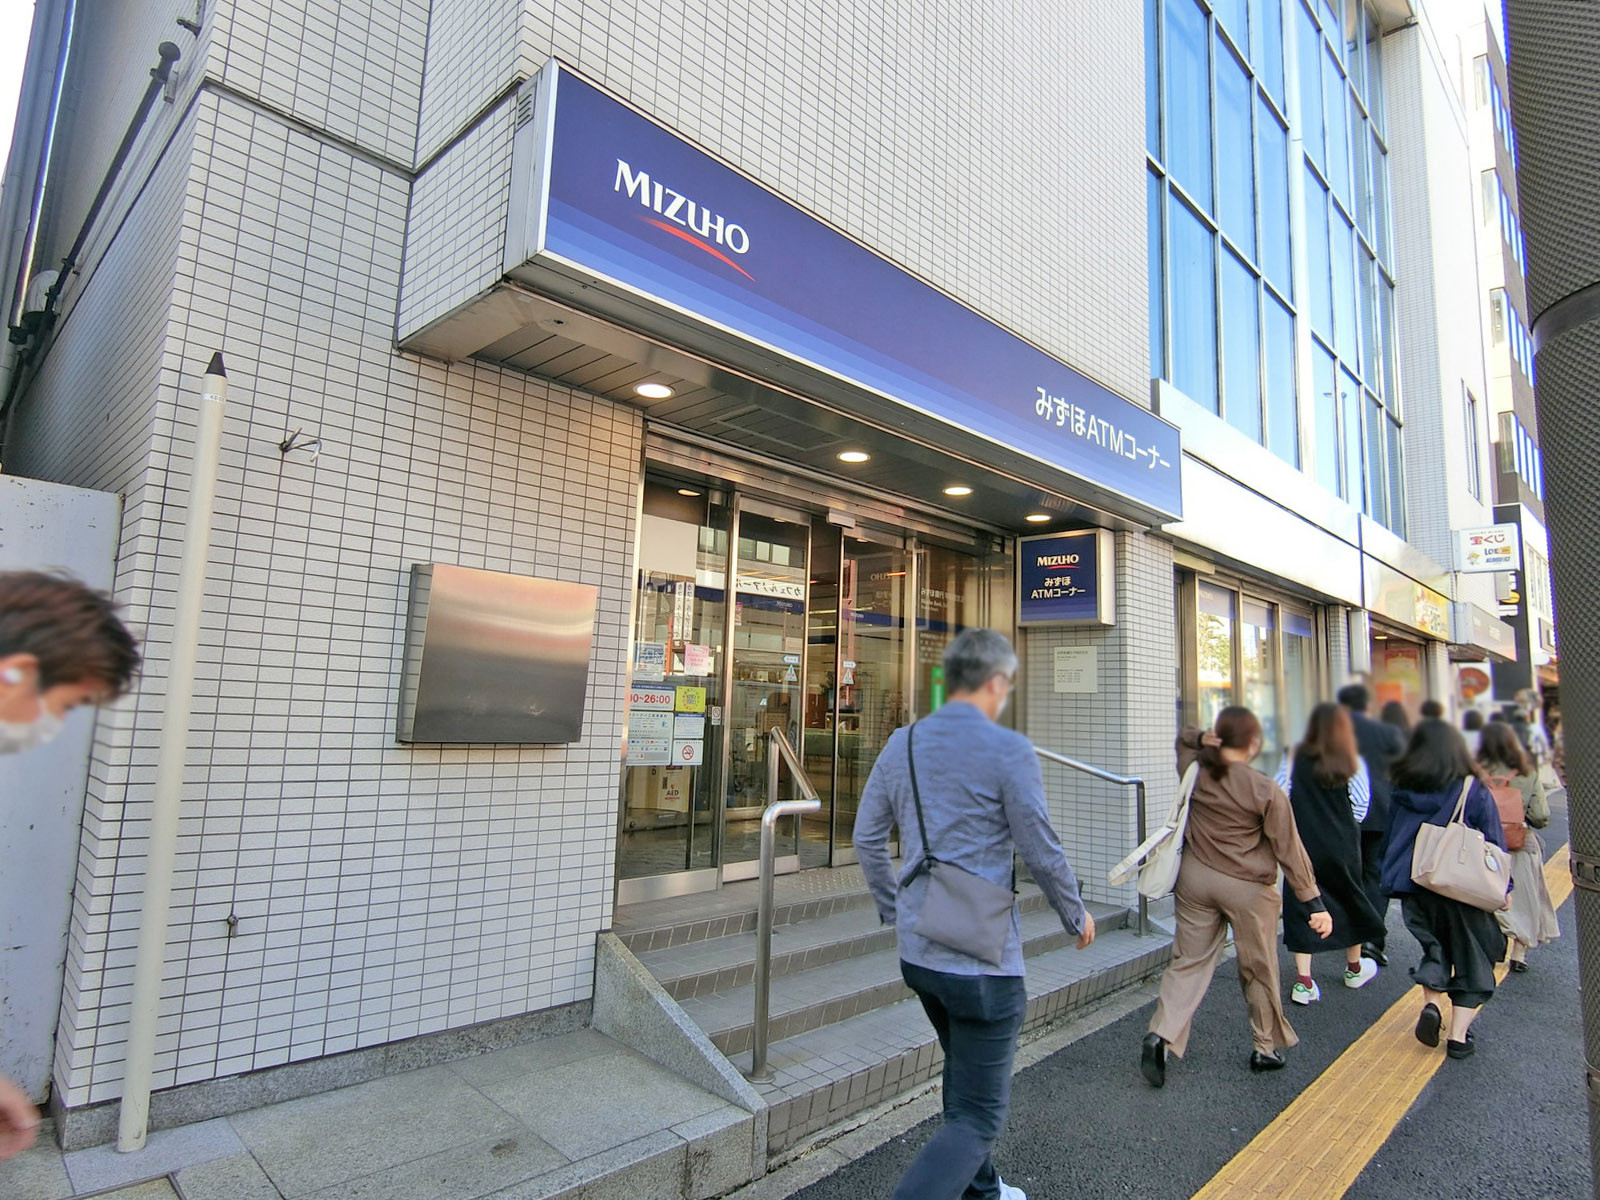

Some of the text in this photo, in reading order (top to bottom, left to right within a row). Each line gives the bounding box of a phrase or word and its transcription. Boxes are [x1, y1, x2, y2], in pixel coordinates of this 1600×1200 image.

[614, 158, 750, 254] MIZUHO
[1035, 386, 1171, 470] みずほATMコーナー
[1037, 554, 1080, 567] MIZUHO
[1044, 576, 1072, 588] みずほ
[1031, 587, 1086, 600] ATMコーナー
